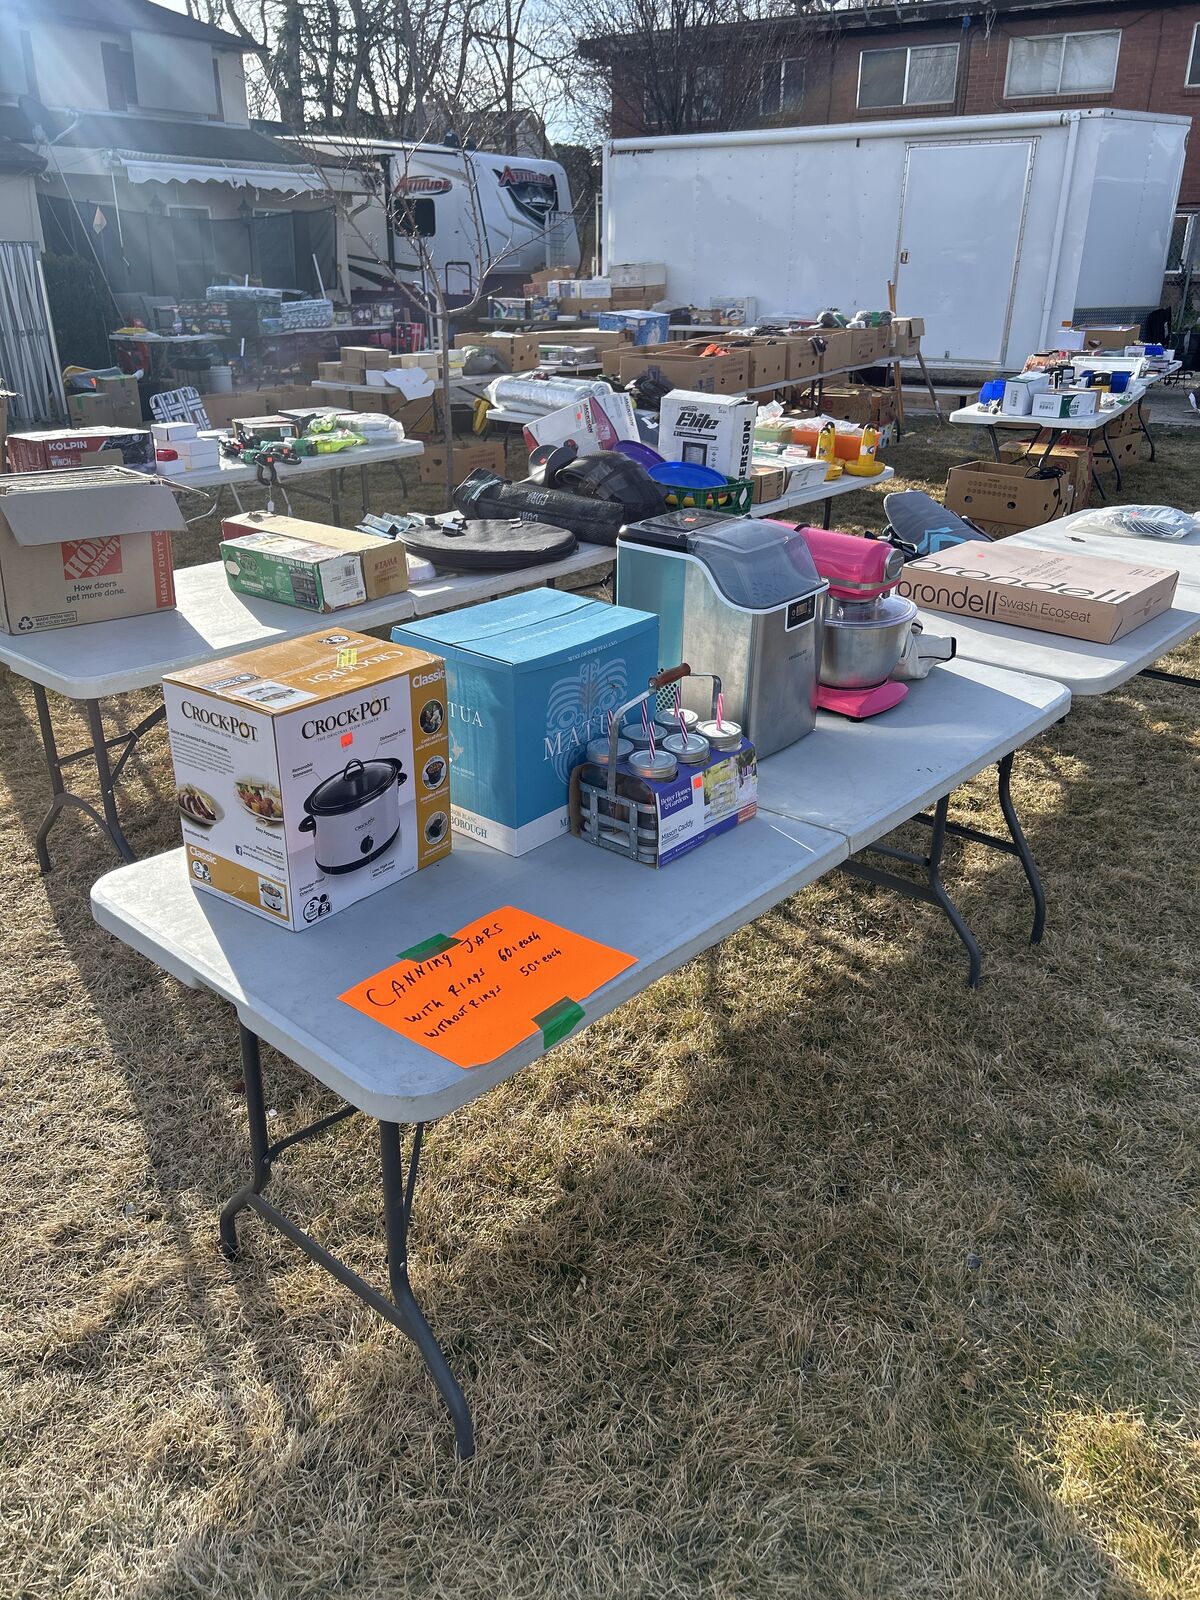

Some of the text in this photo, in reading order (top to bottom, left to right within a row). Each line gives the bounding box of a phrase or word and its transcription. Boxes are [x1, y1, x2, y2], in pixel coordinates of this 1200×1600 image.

[675, 412, 721, 430] Elite
[48, 440, 88, 451] KOLPIN
[50, 457, 72, 467] WINCH
[156, 541, 166, 567] DUTY
[66, 587, 127, 604] get more done.
[73, 581, 117, 593] How doers
[160, 572, 169, 603] HEAVY
[998, 595, 1038, 612] Swash
[1040, 602, 1092, 623] Ecoseat
[411, 669, 446, 689] Classic
[660, 793, 676, 806] Better
[661, 828, 678, 840] Mason
[678, 820, 694, 832] Caddy
[189, 846, 217, 865] Classic
[309, 902, 315, 911] 5
[459, 922, 504, 954] JARS
[518, 931, 541, 949] each
[541, 948, 562, 963] each
